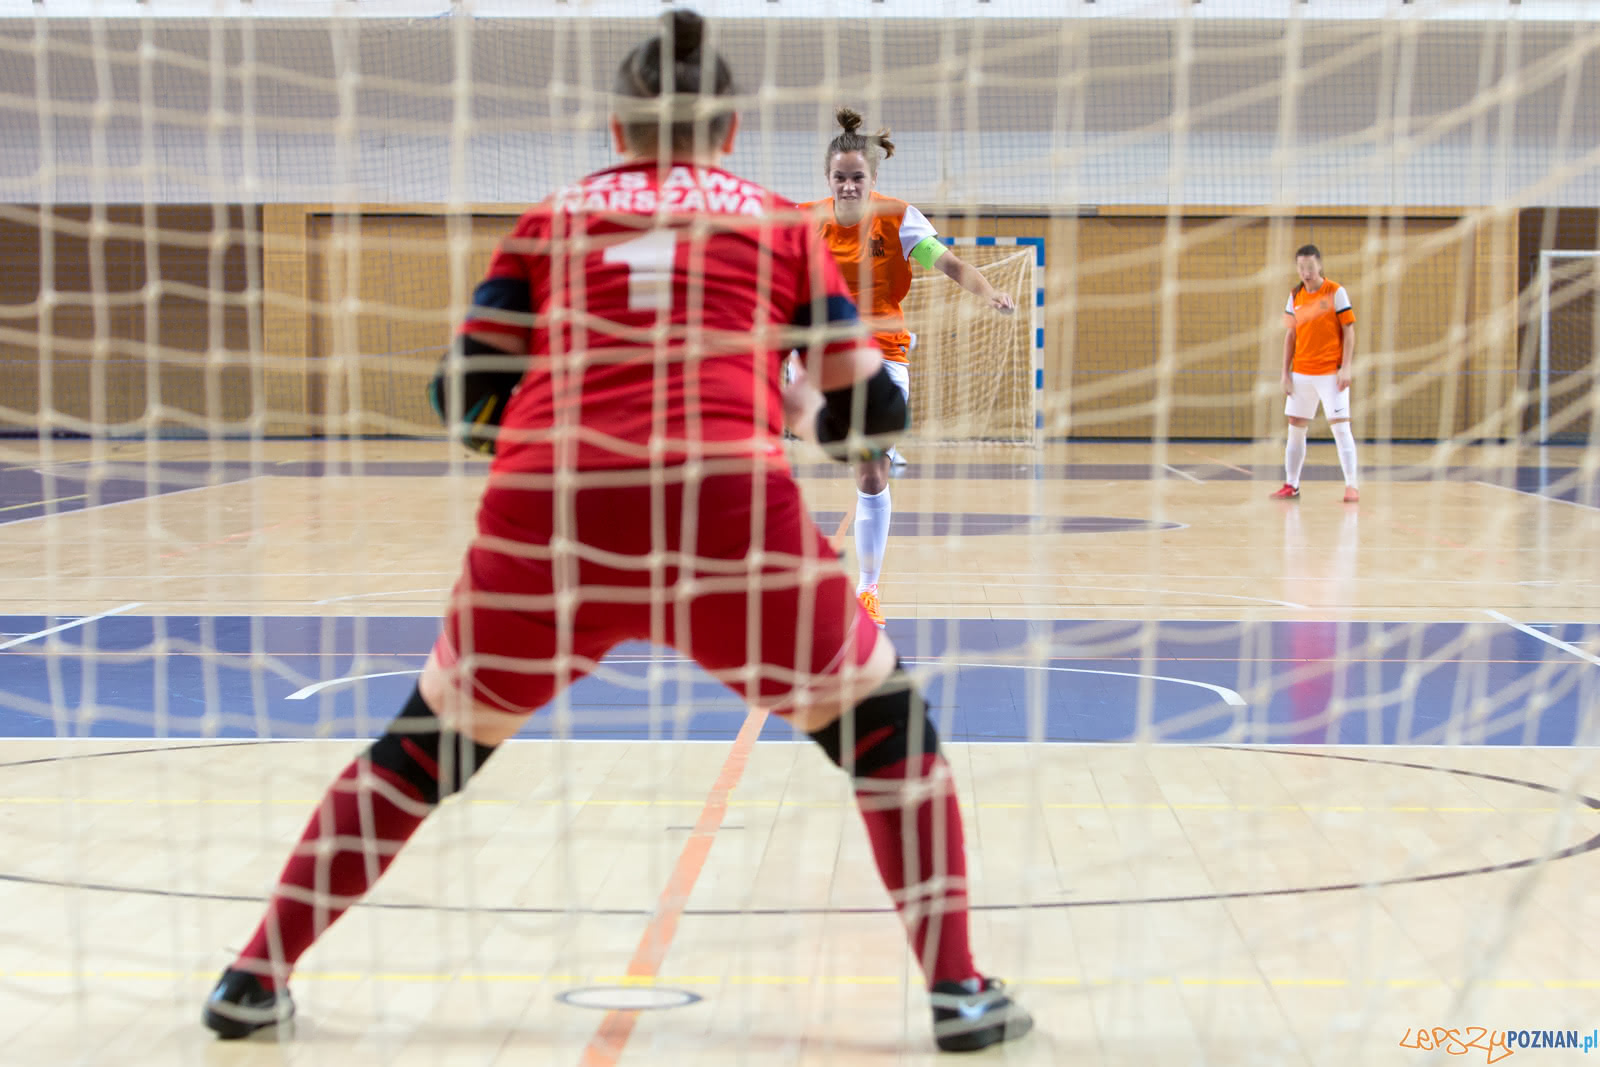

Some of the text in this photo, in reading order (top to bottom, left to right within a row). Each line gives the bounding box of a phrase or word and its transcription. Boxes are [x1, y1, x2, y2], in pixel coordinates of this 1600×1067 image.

[563, 171, 649, 194] ZS
[554, 190, 764, 217] WARSZAWA
[603, 229, 677, 312] 1
